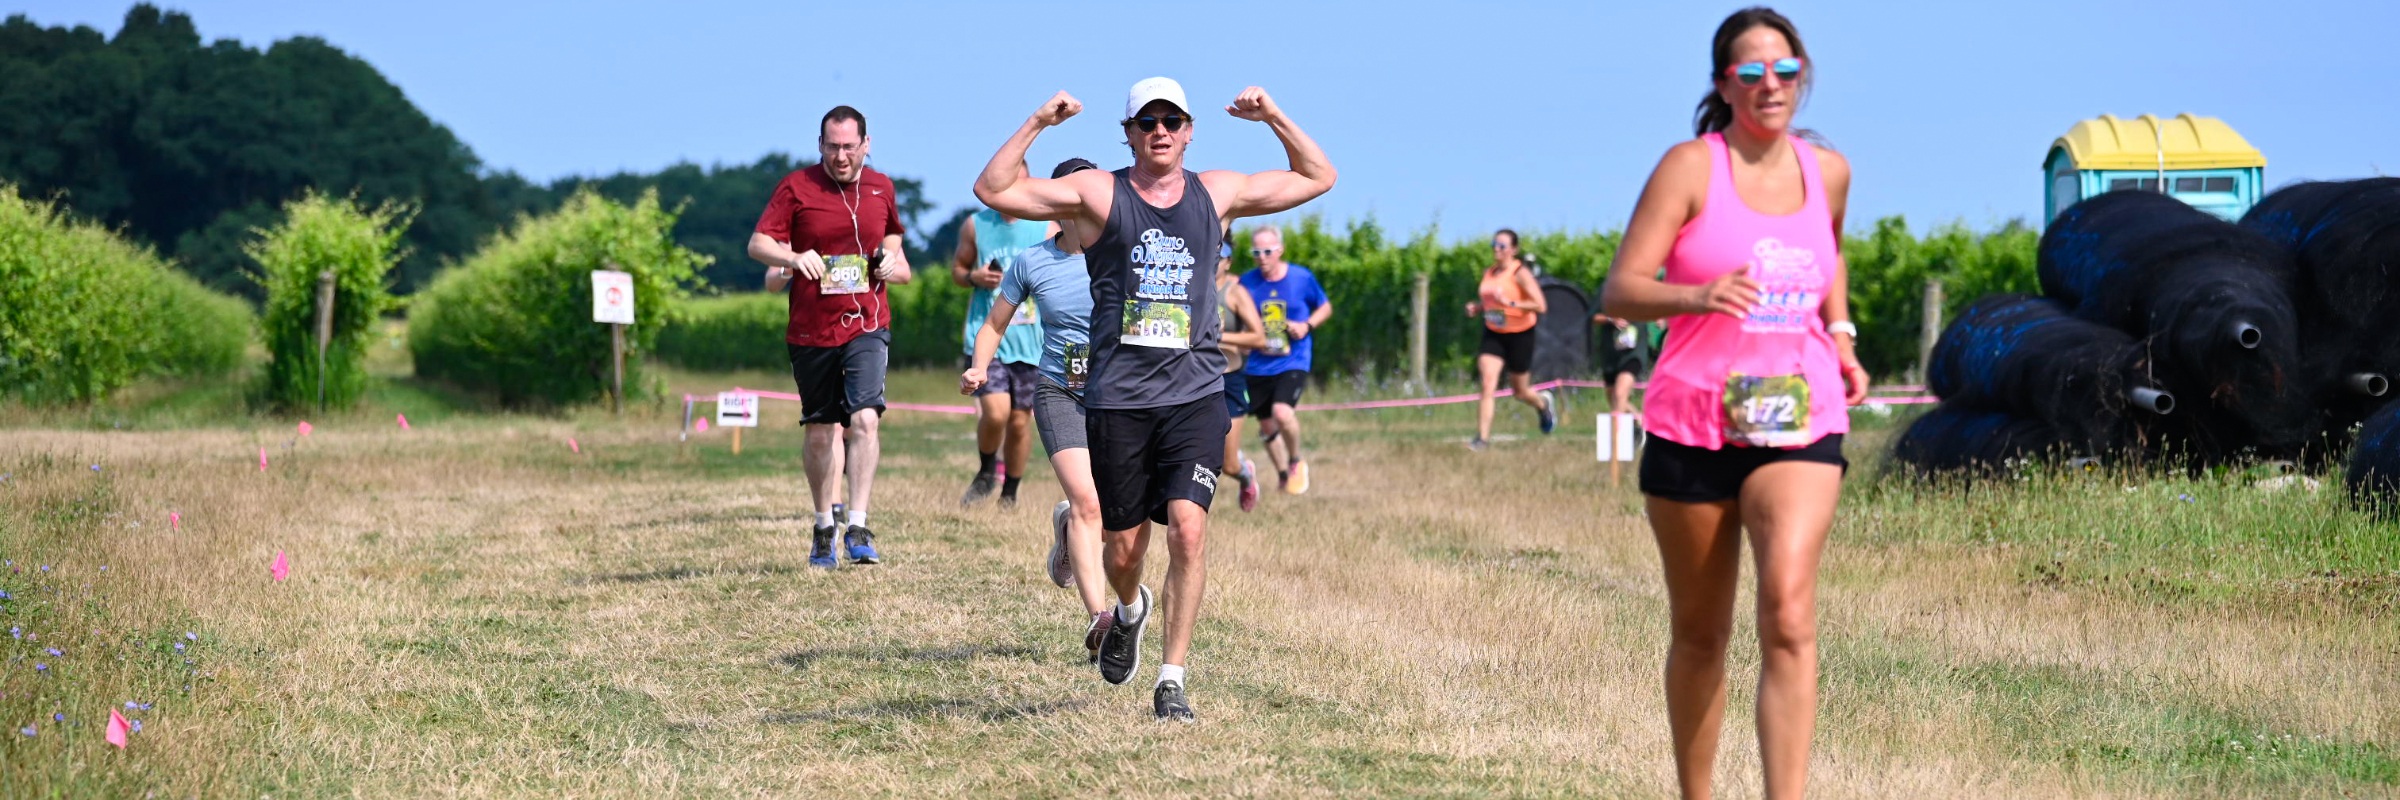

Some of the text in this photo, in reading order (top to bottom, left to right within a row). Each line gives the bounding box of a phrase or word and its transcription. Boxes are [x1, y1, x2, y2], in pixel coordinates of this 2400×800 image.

[830, 266, 860, 282] 360
[1139, 283, 1173, 296] PINDAR
[1137, 318, 1176, 339] 103
[1742, 394, 1797, 424] 172
